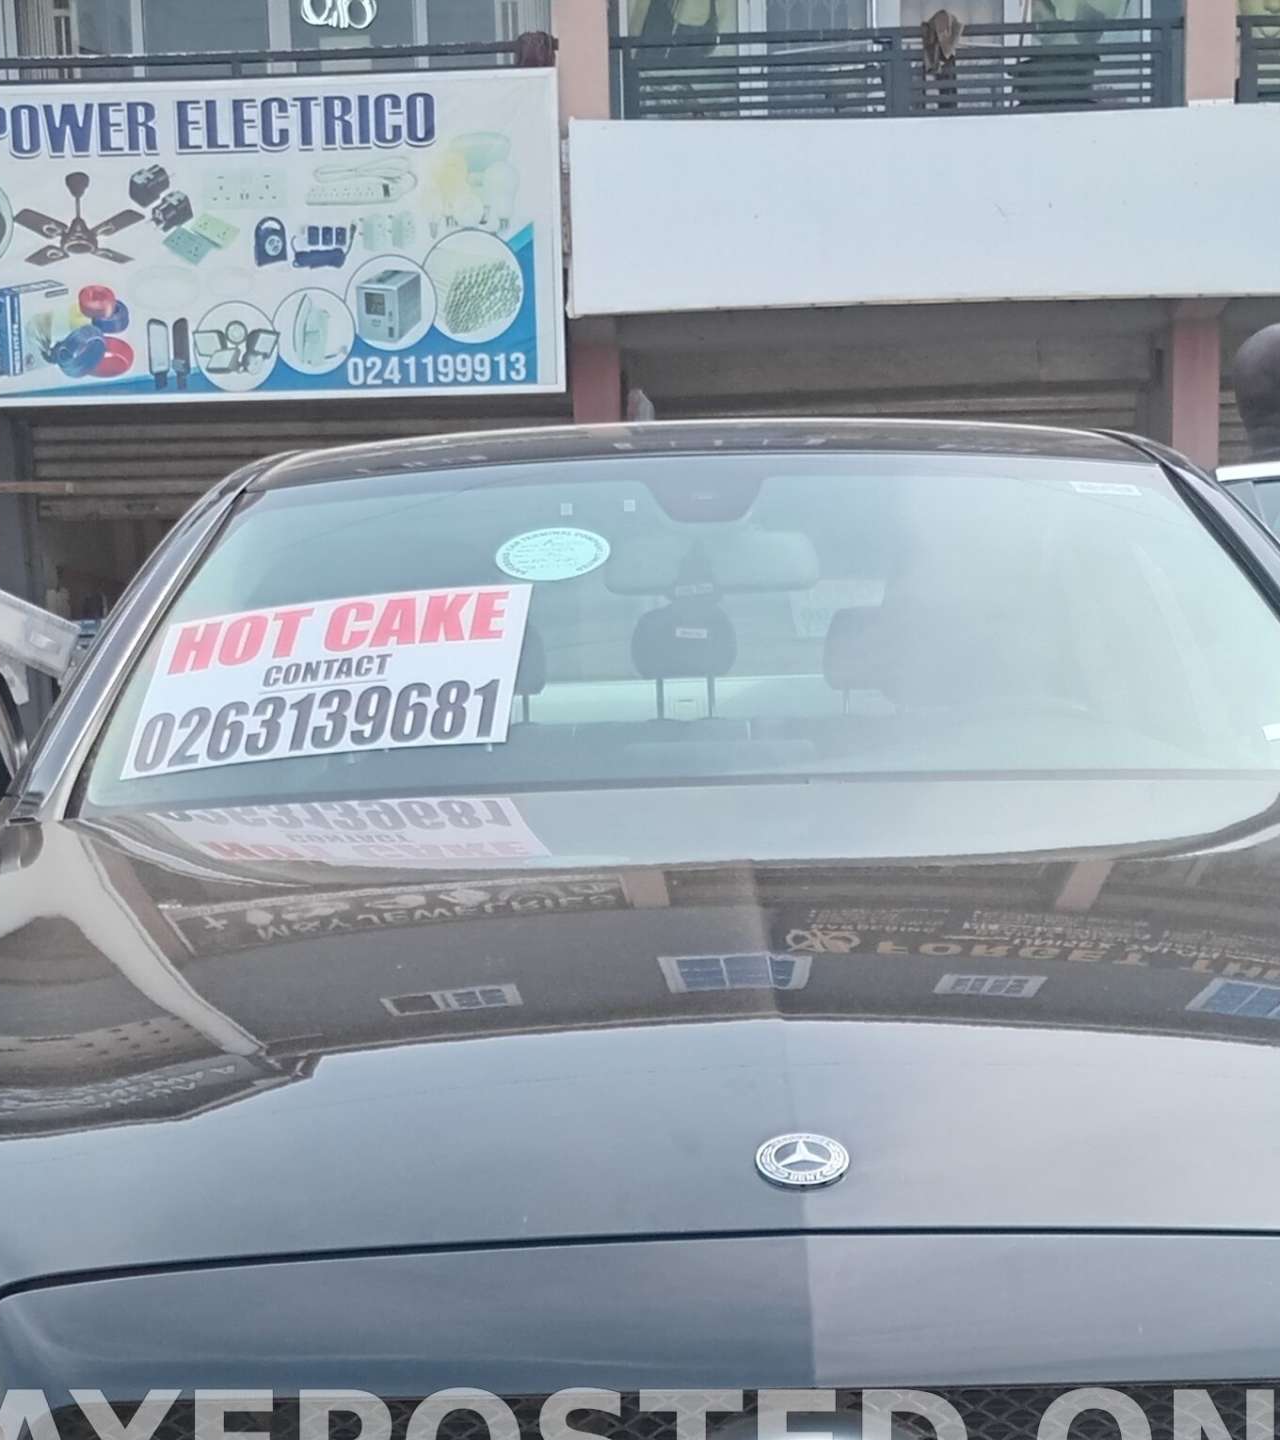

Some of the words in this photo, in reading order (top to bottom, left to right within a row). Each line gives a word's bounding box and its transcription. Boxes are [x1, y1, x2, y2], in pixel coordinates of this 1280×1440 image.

[175, 92, 437, 154] ELECTRICO
[346, 352, 528, 386] 0241199913
[167, 607, 314, 675] HOT
[324, 591, 511, 653] CAKE
[262, 653, 393, 689] CONTACT
[133, 679, 501, 774] 0263139681
